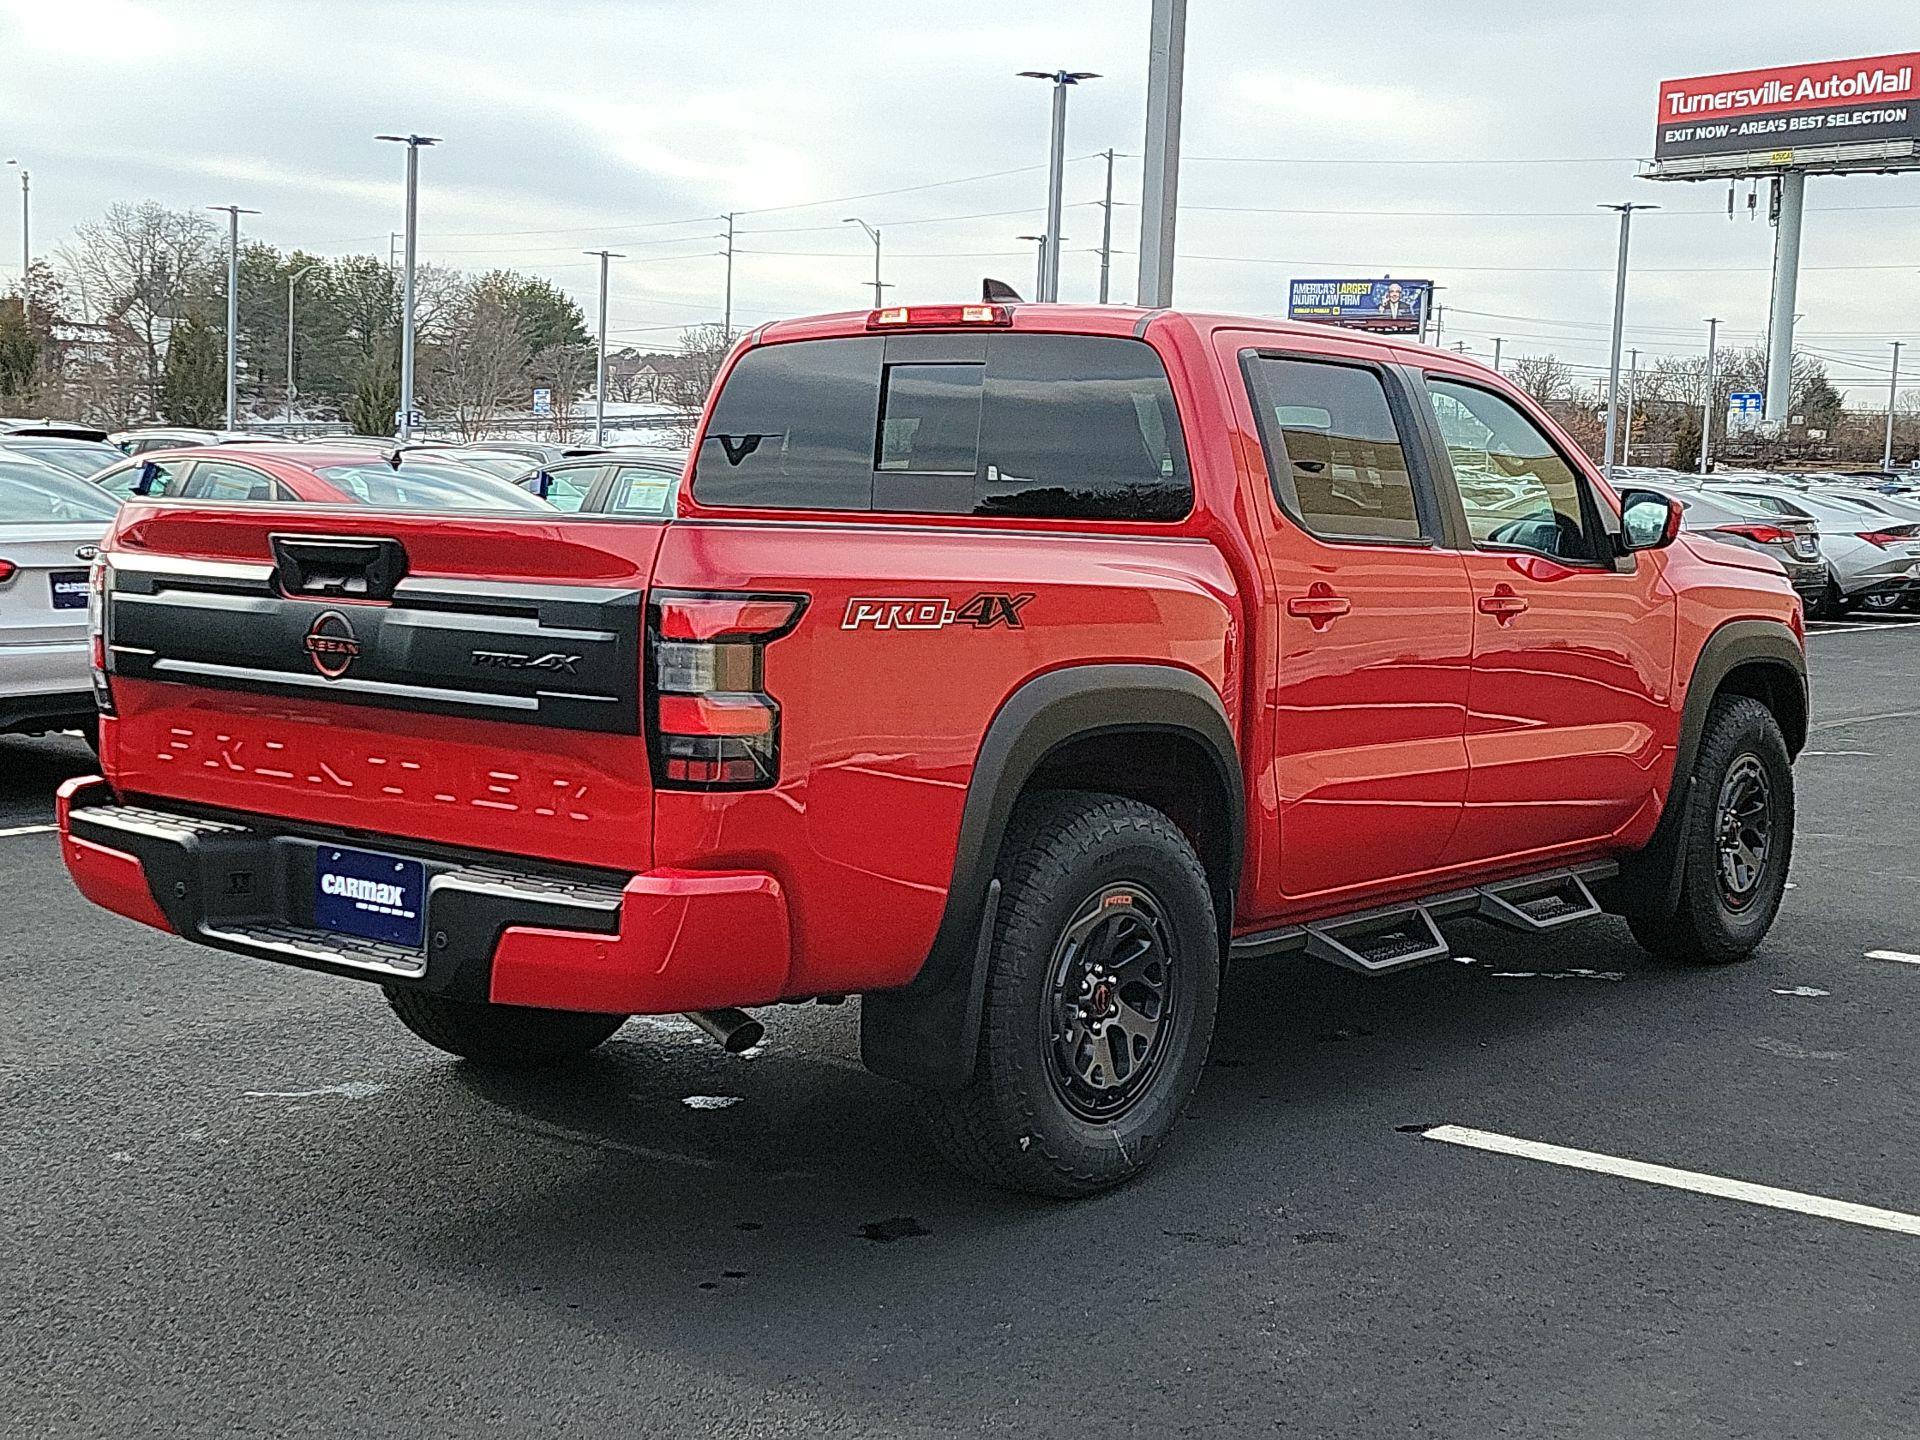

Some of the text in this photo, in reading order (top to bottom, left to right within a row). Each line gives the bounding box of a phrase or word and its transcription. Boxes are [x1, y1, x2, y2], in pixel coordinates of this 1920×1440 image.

[1667, 67, 1912, 115] Turnersville AutoMall
[1665, 128, 1694, 143] EXIT
[1695, 125, 1730, 140] NOW
[1738, 120, 1786, 136] AREA'S
[1790, 115, 1826, 132] BEST
[1826, 108, 1907, 126] SELECTION
[1292, 295, 1360, 305] INJURY LAW FIRM
[1293, 283, 1371, 294] AMERICA'S LARGEST
[410, 412, 419, 426] E
[157, 727, 589, 821] FRONTIER
